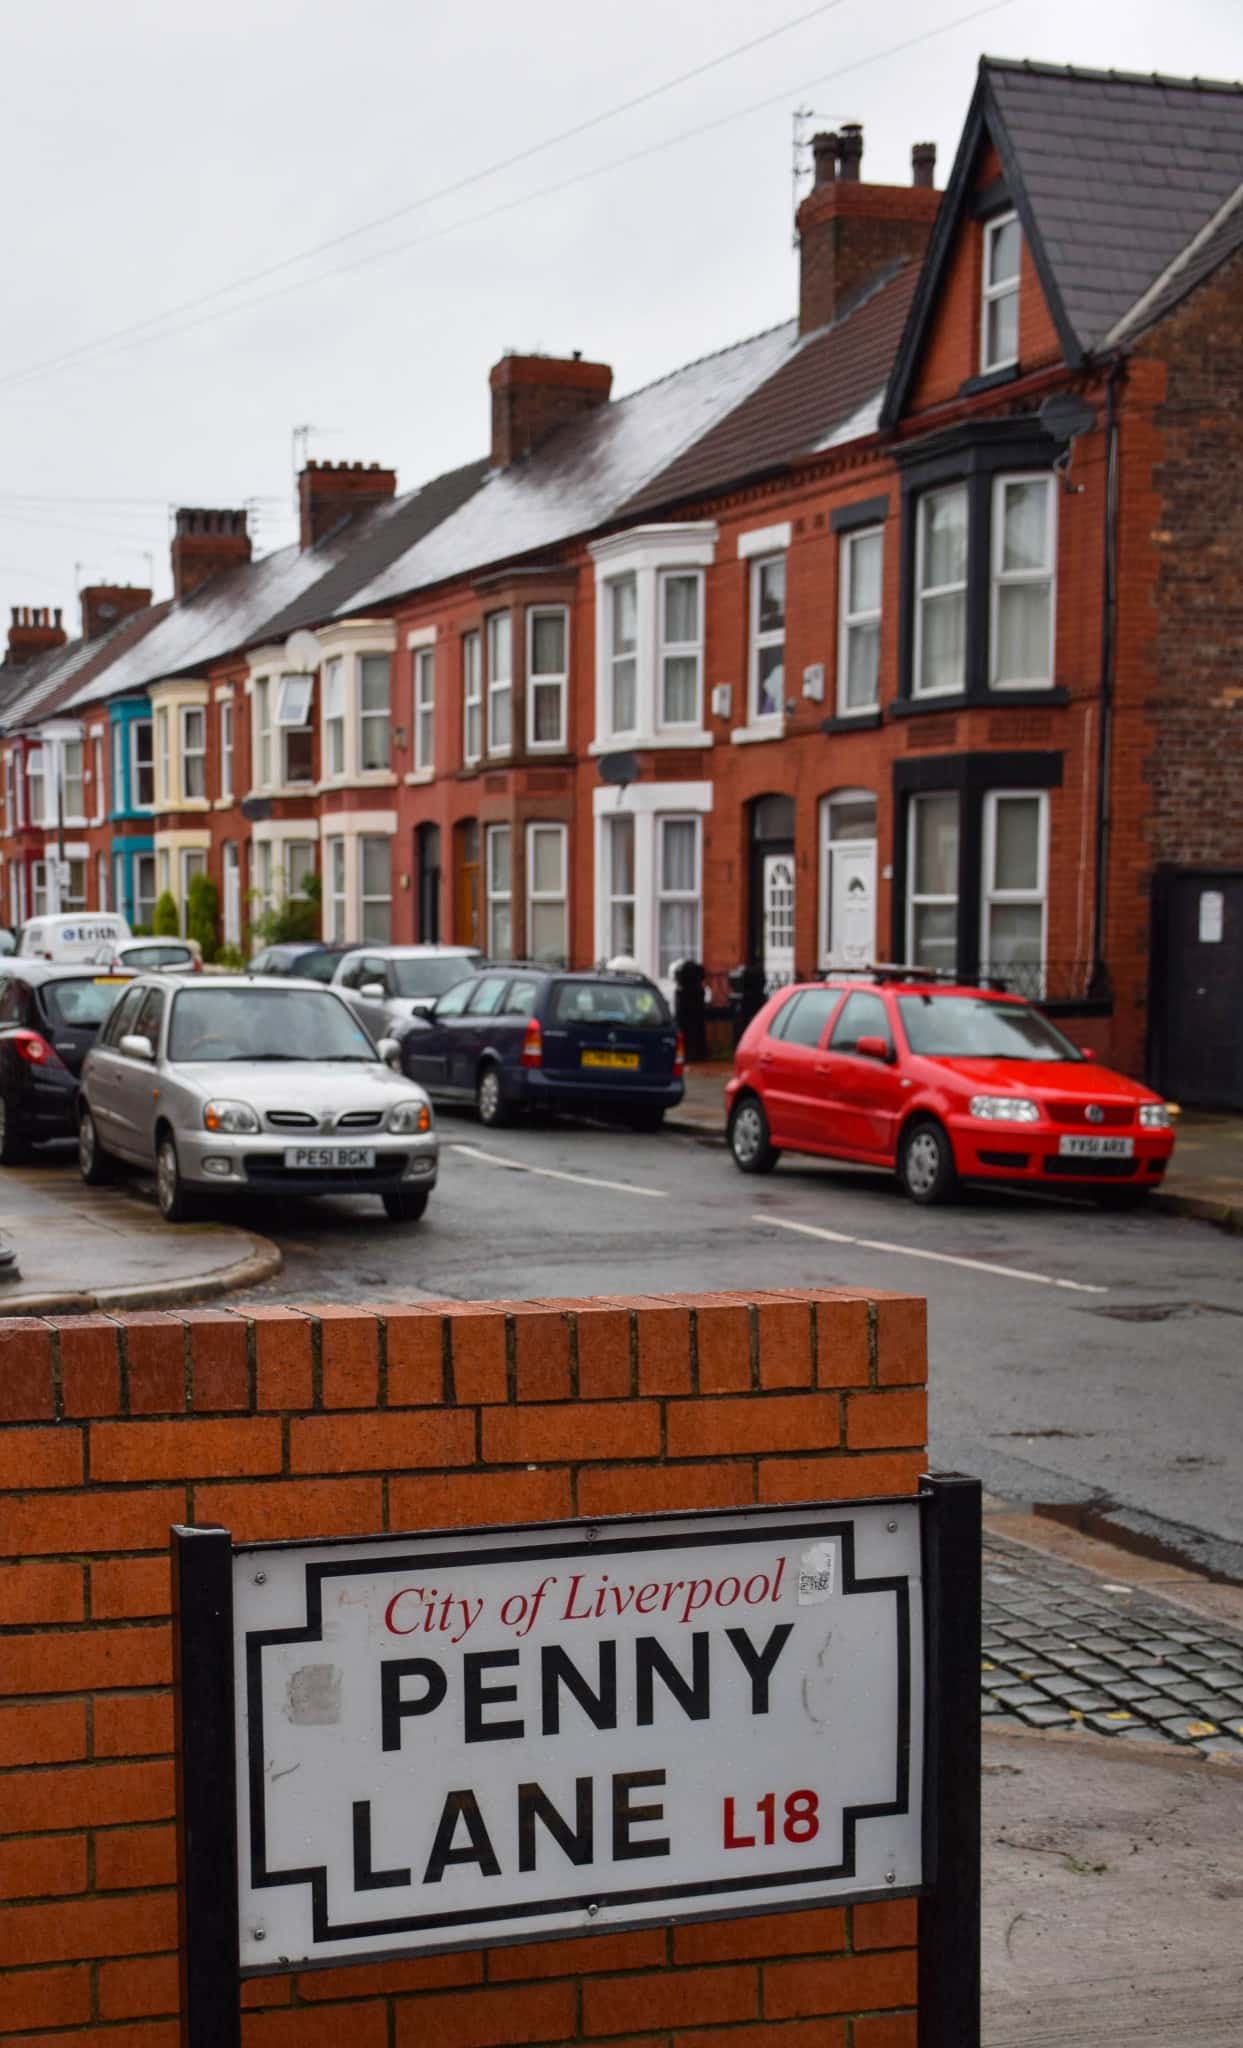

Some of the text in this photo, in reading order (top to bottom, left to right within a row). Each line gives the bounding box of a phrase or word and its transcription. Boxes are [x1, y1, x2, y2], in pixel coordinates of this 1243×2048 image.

[296, 1150, 368, 1166] PE51 BGK
[384, 1557, 786, 1644] City of Liverpool
[380, 1623, 795, 1753] PENNY
[352, 1768, 820, 1893] LANE L18
